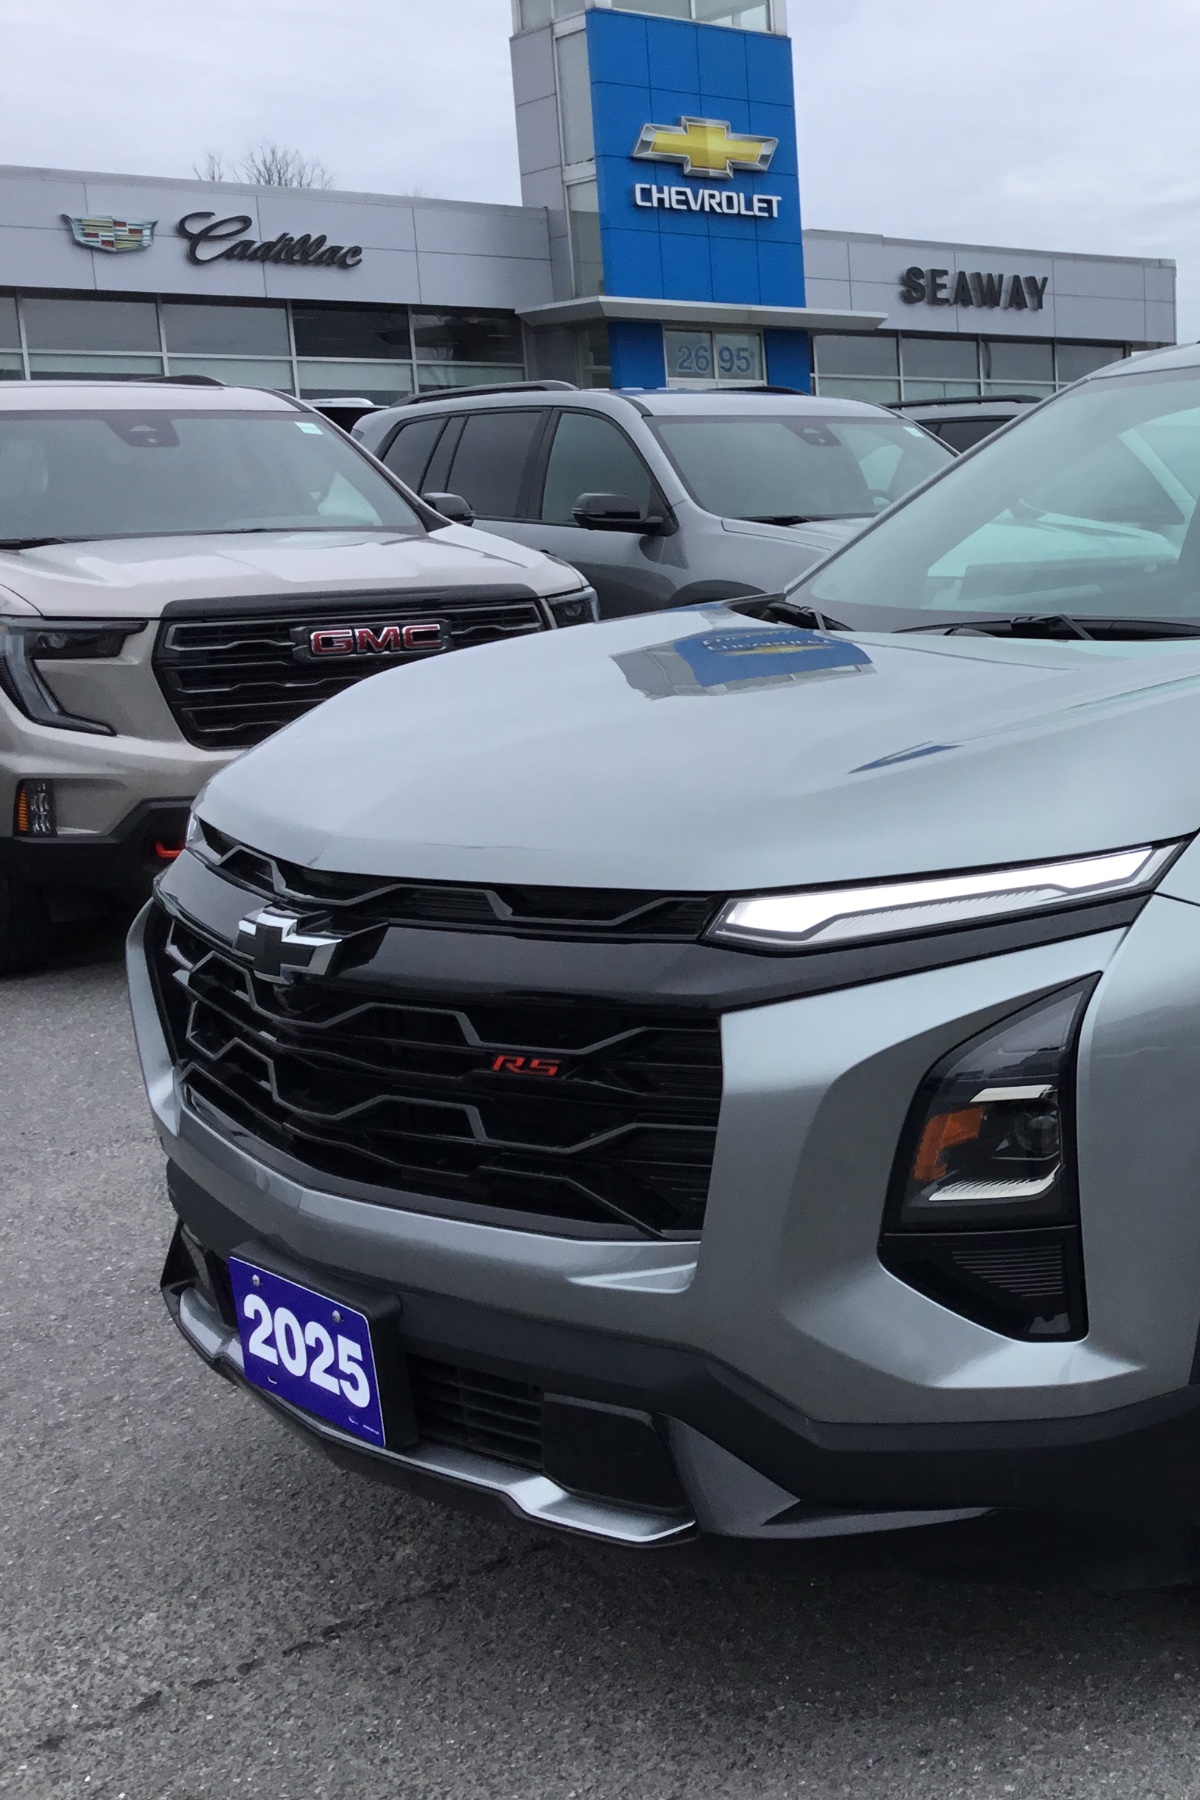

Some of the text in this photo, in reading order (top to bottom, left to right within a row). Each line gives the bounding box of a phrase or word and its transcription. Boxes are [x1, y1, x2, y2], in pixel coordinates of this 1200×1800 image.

[634, 183, 782, 218] CHEVROLET
[177, 211, 363, 269] Cadillac
[902, 266, 1049, 311] SEAWAY
[310, 624, 442, 655] GMC
[492, 1055, 561, 1077] RS
[243, 1293, 371, 1409] 2025
